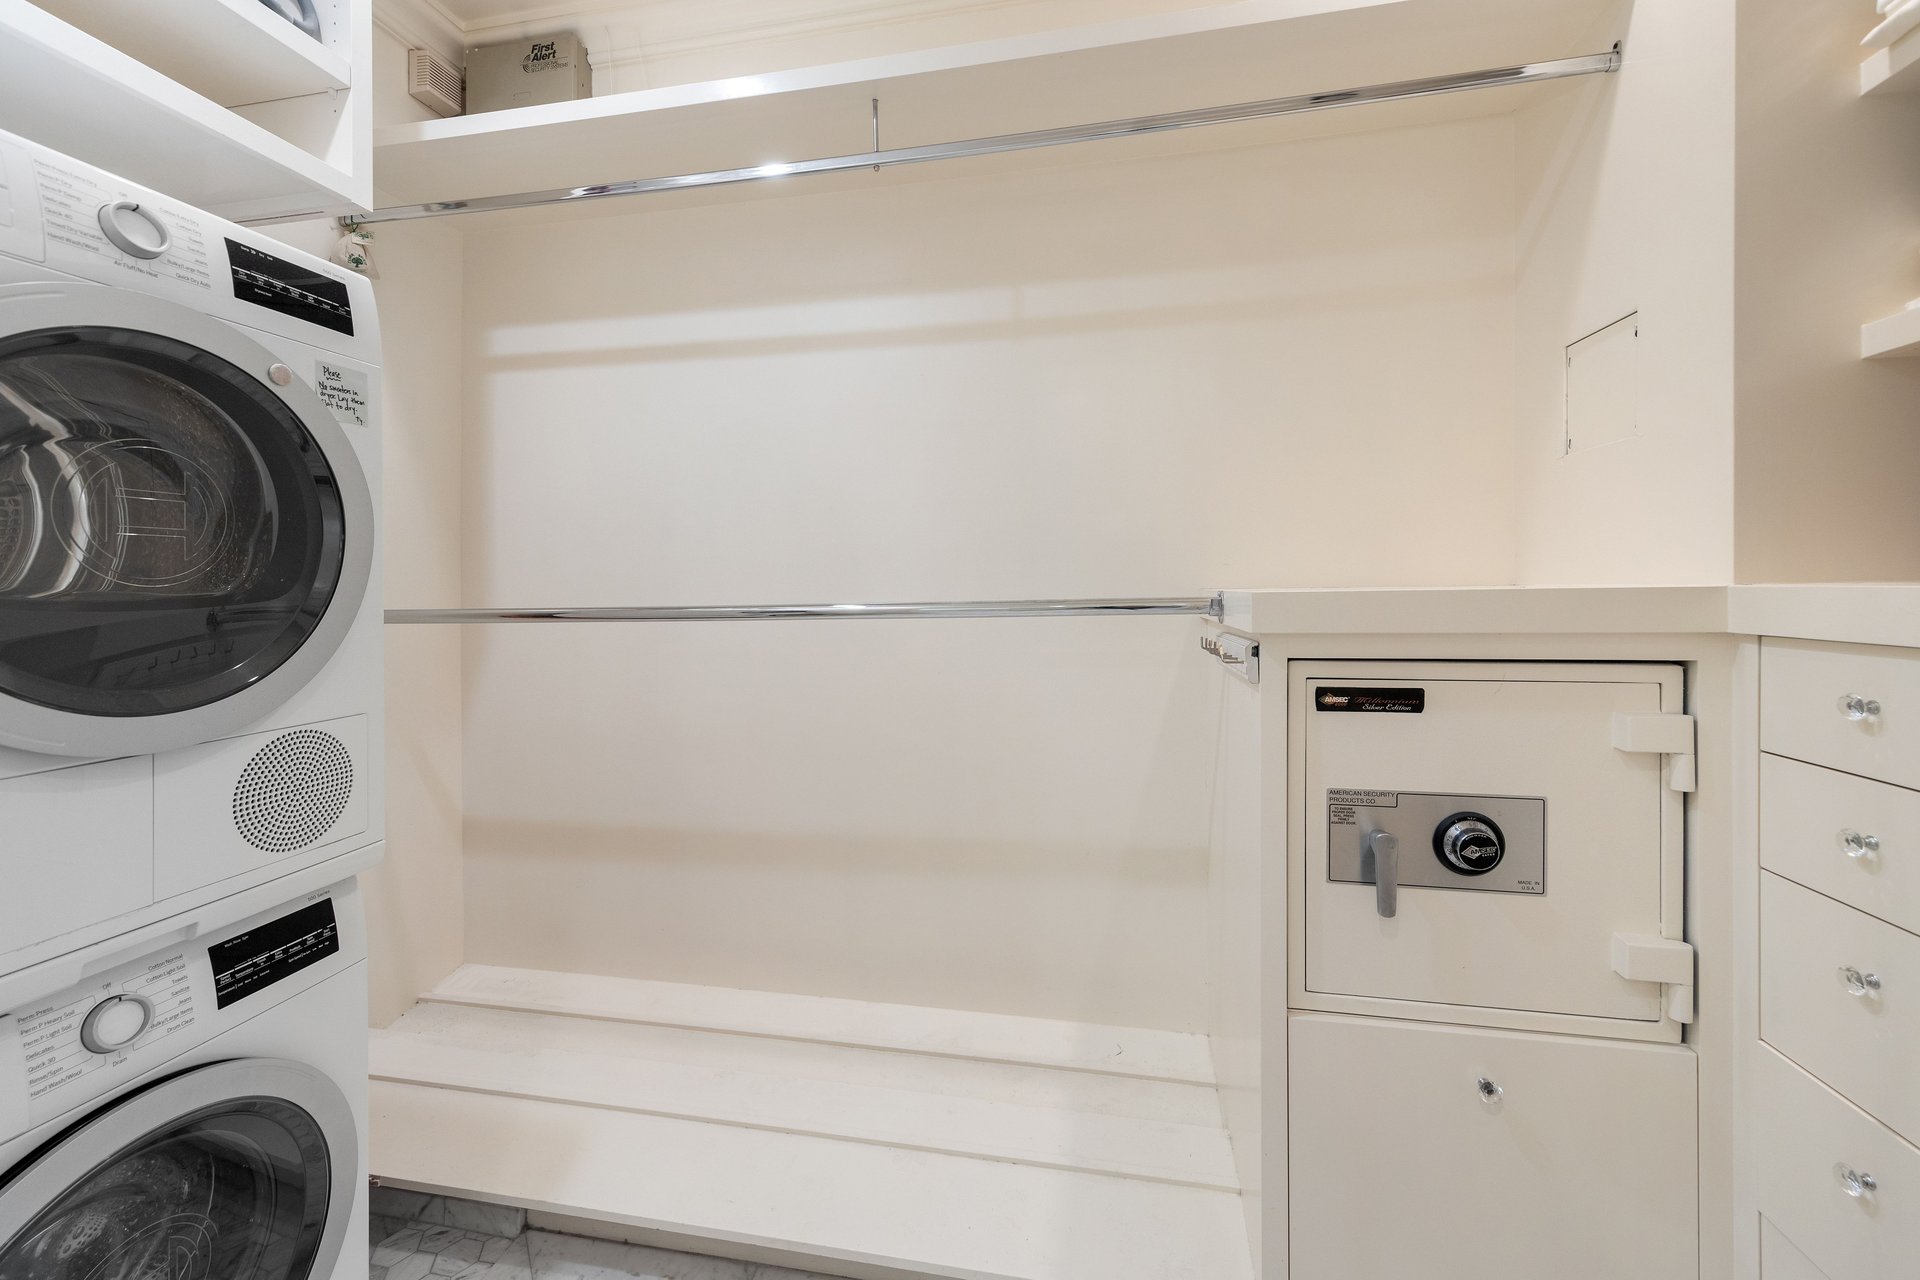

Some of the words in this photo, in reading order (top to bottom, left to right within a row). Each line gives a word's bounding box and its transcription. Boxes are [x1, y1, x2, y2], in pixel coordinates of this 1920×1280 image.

[531, 42, 555, 54] First
[531, 50, 557, 62] Alert
[322, 365, 341, 379] Please
[318, 381, 327, 391] No
[336, 402, 343, 410] to
[337, 394, 349, 409] Lay
[1329, 789, 1361, 797] AMERICAN
[1329, 796, 1365, 804] PRODUCTS
[147, 960, 165, 971] Cotton
[165, 953, 183, 964] Normal
[146, 973, 163, 984] Cotton
[163, 967, 176, 977] Light
[176, 963, 186, 972] Soil
[171, 975, 188, 984] Towels
[102, 982, 112, 990] Off
[44, 1015, 62, 1026] Heavy
[64, 1009, 76, 1018] Soil
[45, 1028, 61, 1040] Light
[61, 1023, 73, 1032] Soil
[166, 1022, 181, 1033] Drum
[181, 1017, 195, 1027] Clean
[25, 1045, 55, 1061] Delicates
[27, 1061, 46, 1073] Quick
[47, 1056, 57, 1064] 30
[112, 1056, 128, 1067] Drain
[29, 1066, 64, 1085] Rinse/Spin
[30, 1087, 48, 1098] Hand
[48, 1068, 83, 1089] Wash/Wool
